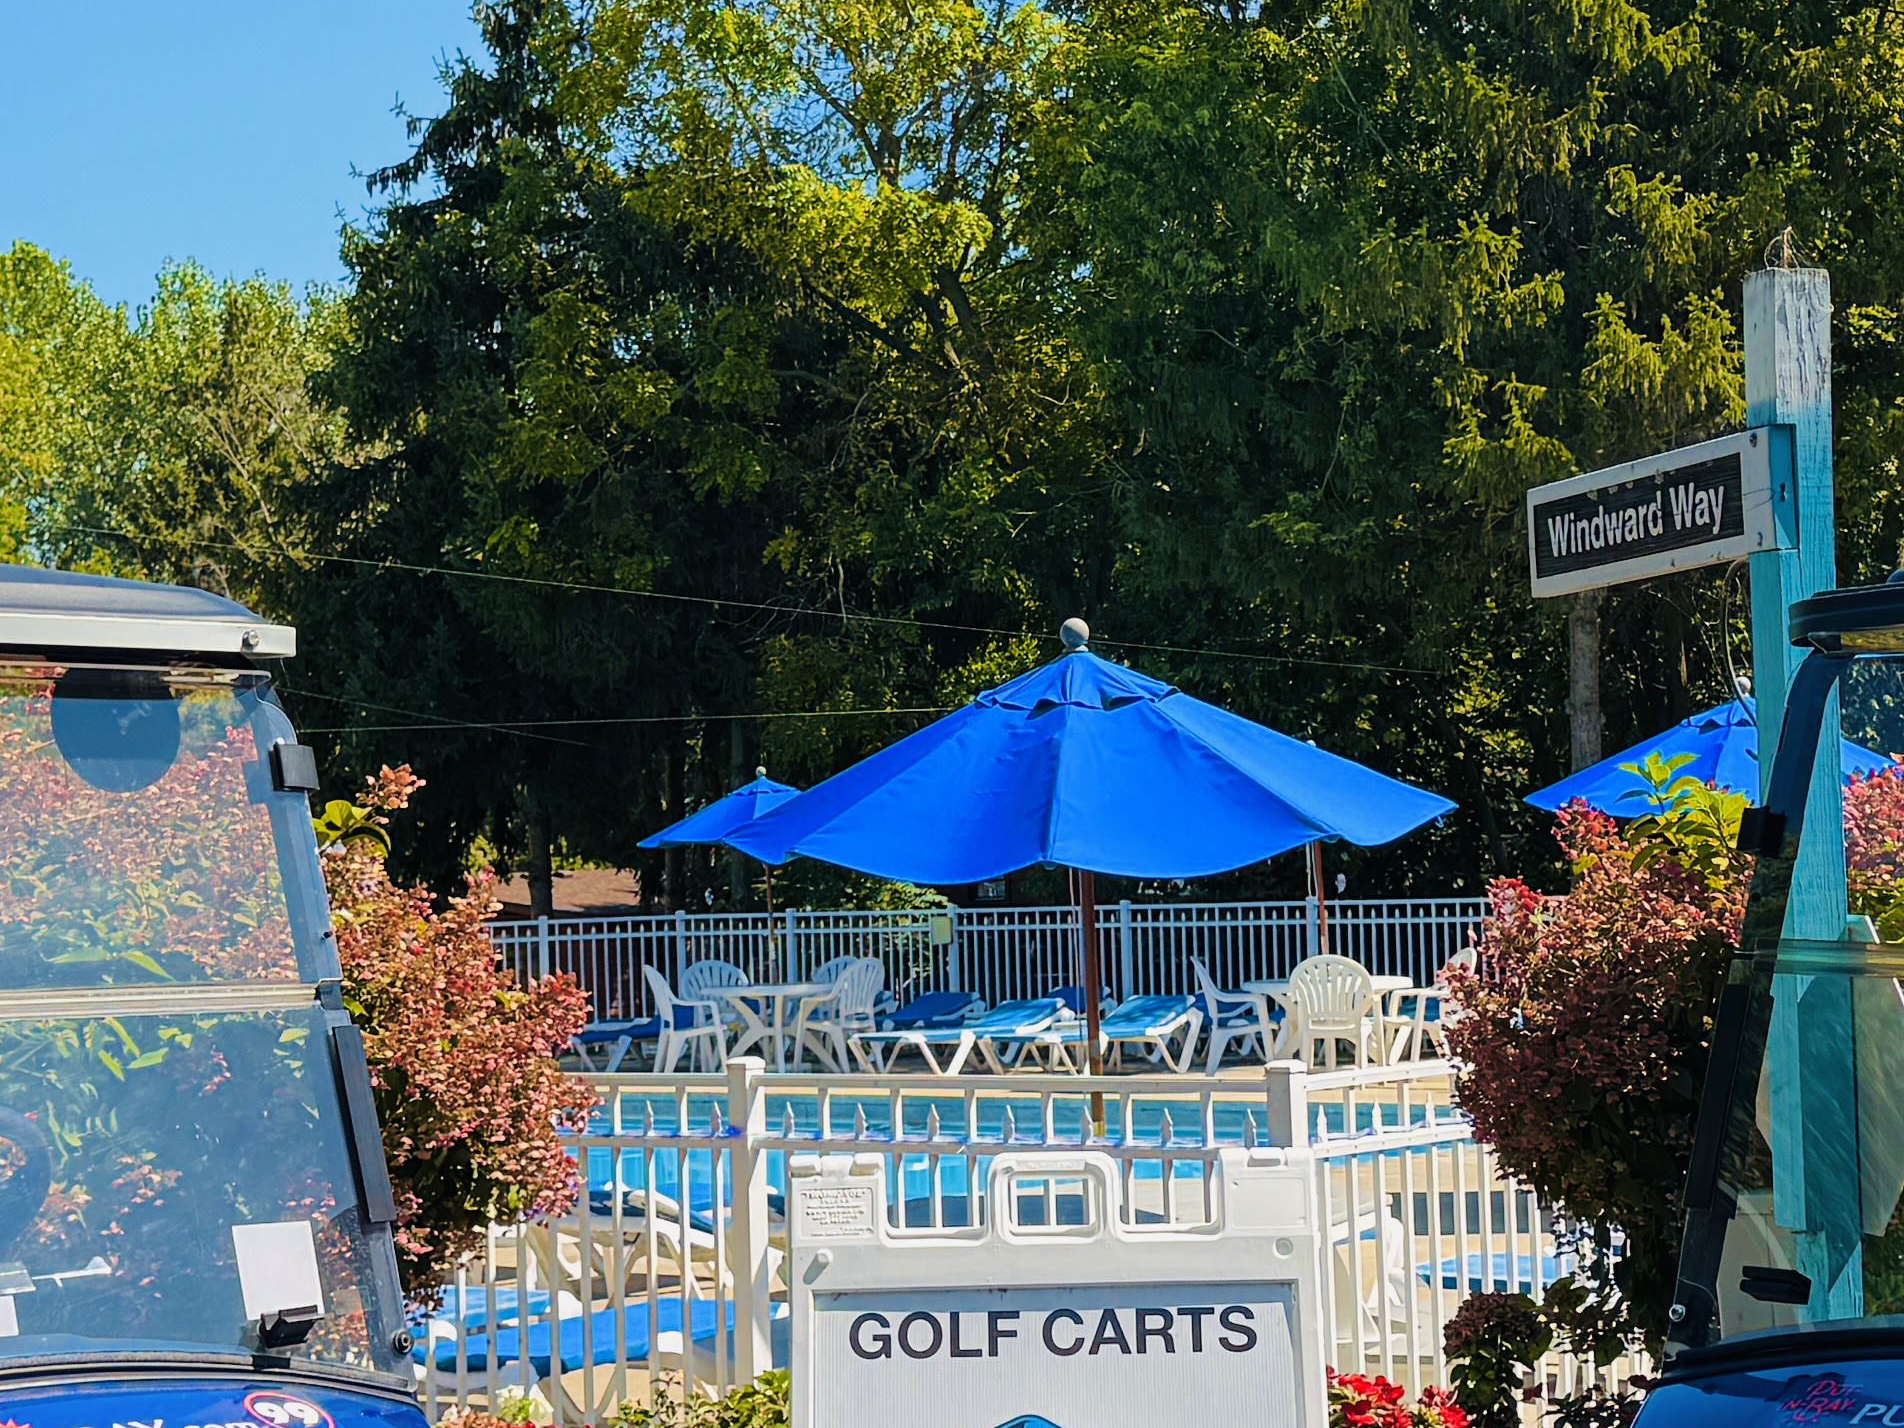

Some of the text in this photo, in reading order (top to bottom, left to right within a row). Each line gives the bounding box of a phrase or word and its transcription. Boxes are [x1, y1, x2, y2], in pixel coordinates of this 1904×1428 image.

[1547, 482, 1725, 558] Windward Way
[849, 1305, 1258, 1359] GOLF CARTS
[253, 1401, 320, 1428] 99
